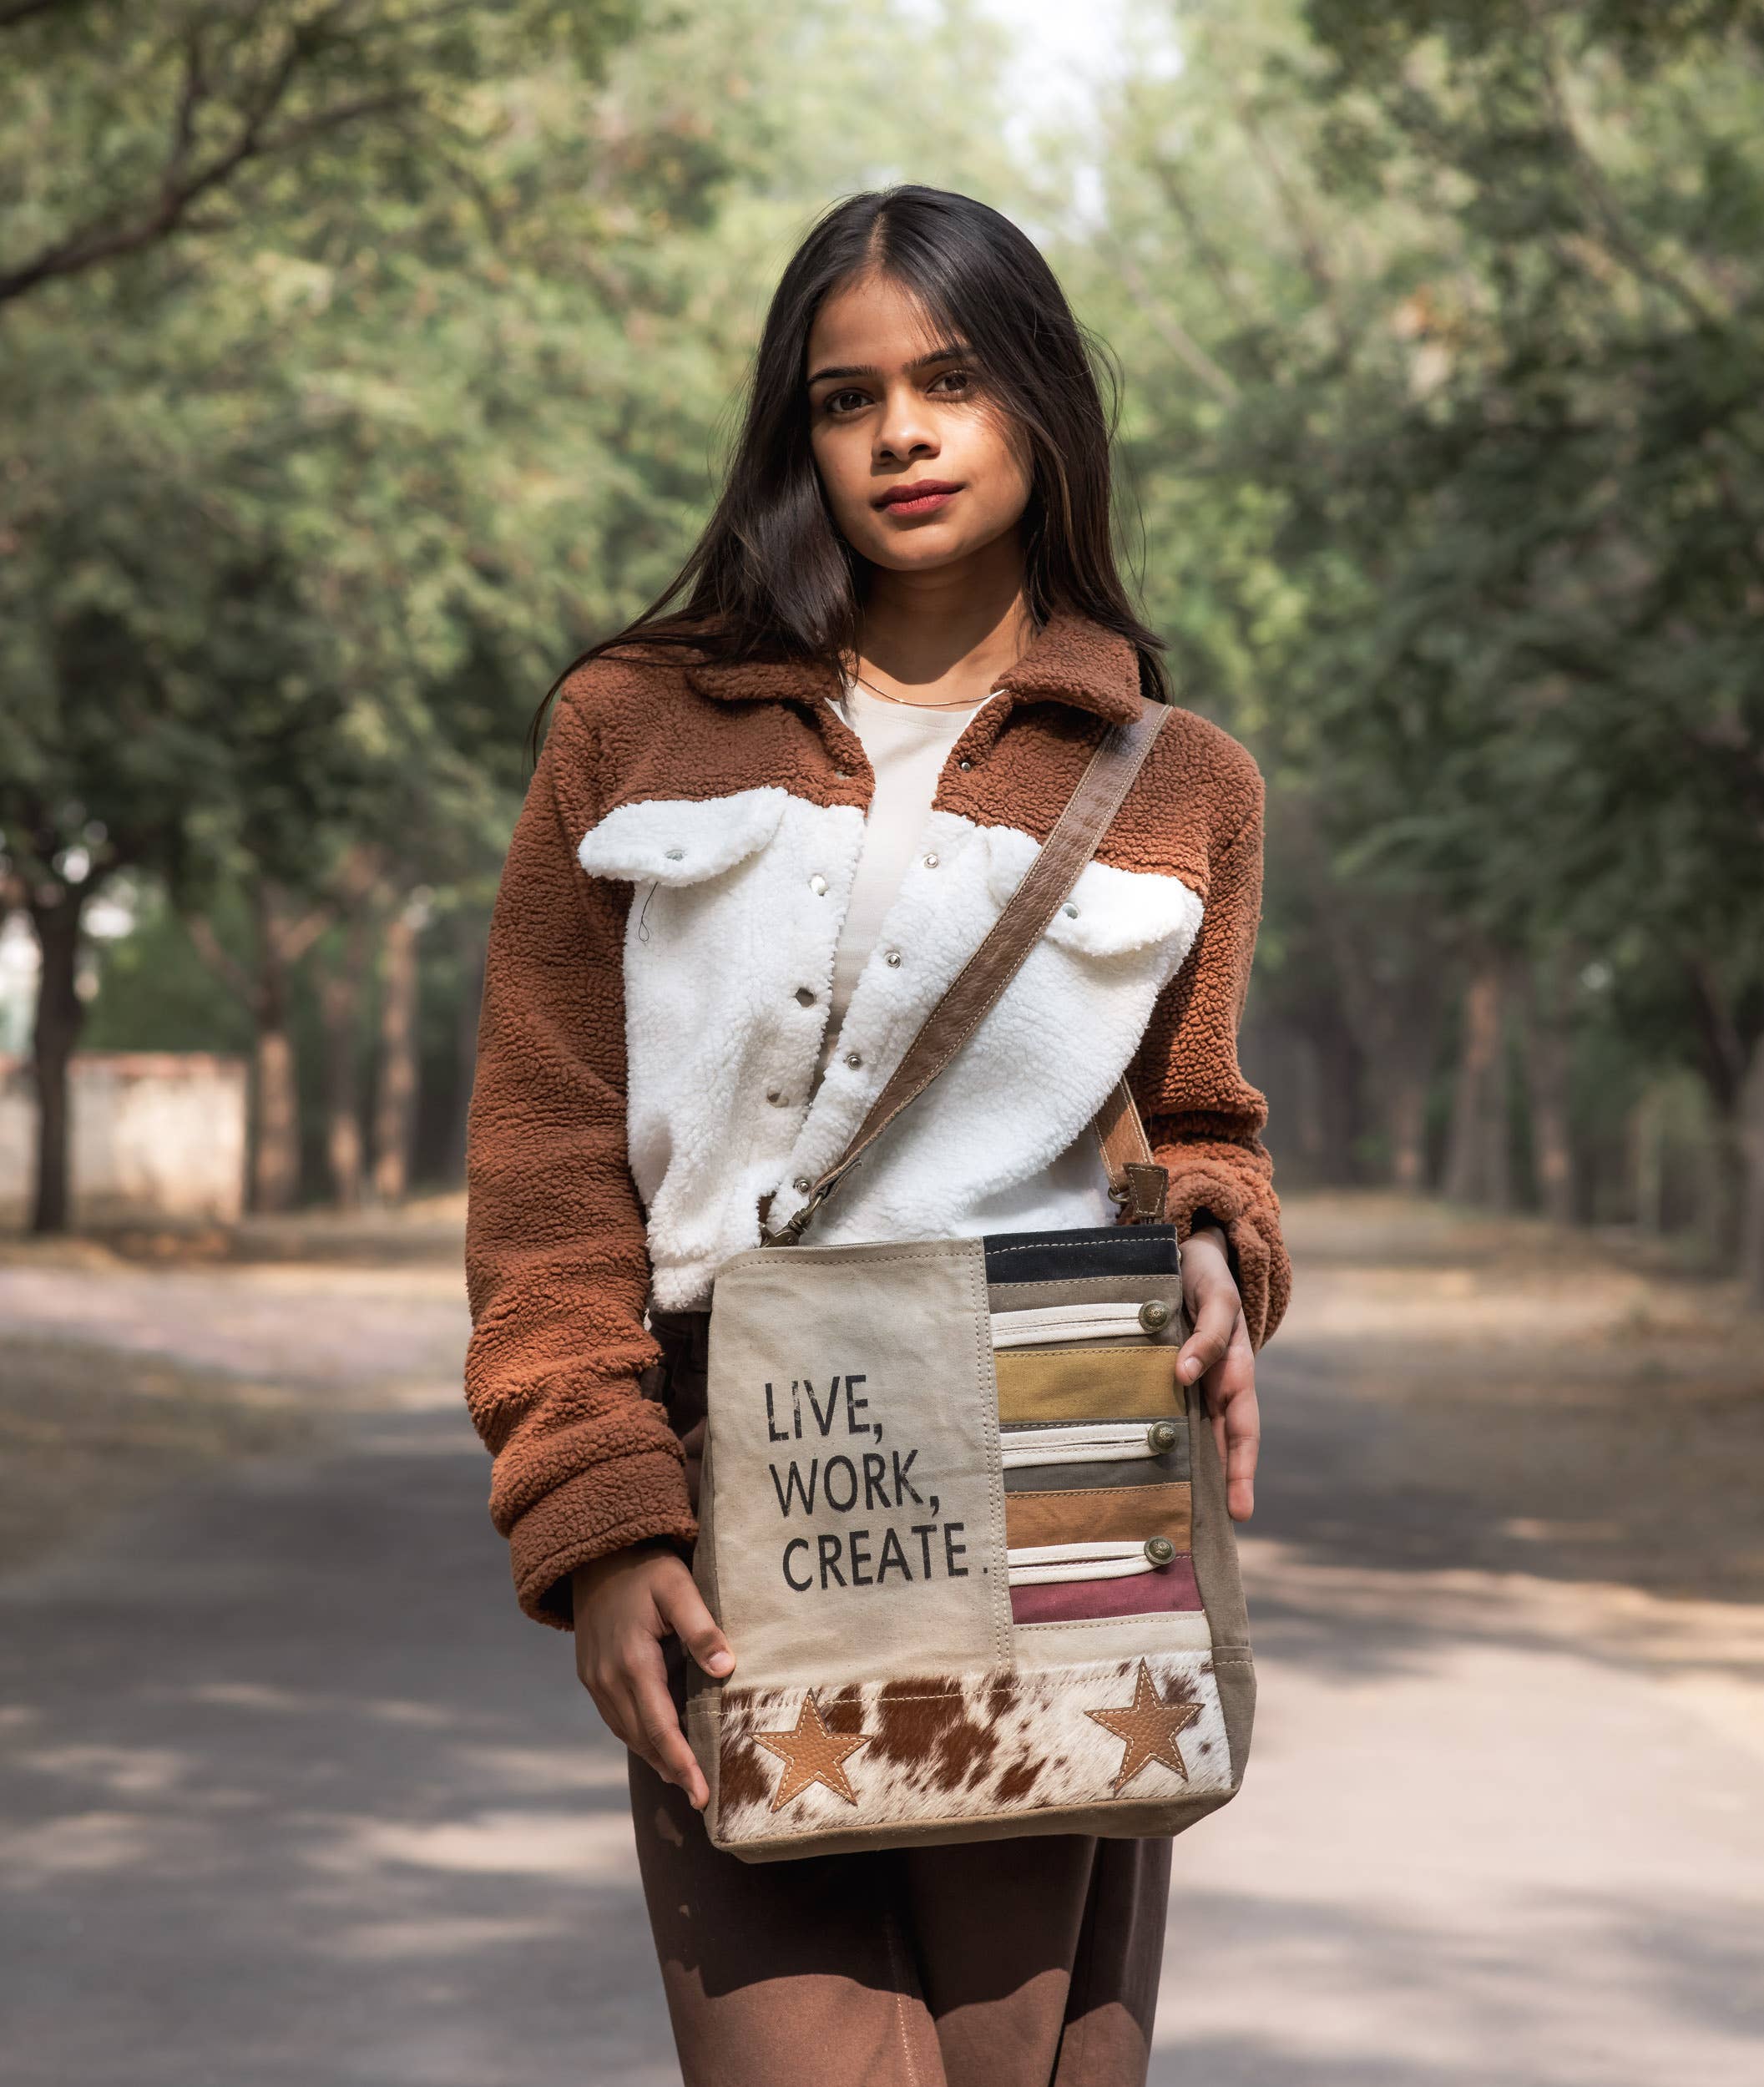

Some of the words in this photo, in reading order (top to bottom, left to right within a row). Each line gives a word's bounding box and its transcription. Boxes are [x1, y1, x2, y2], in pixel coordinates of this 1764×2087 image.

[765, 1374, 882, 1444] LIVE,
[769, 1449, 940, 1518] WORK,
[782, 1522, 988, 1592] CREATE.
